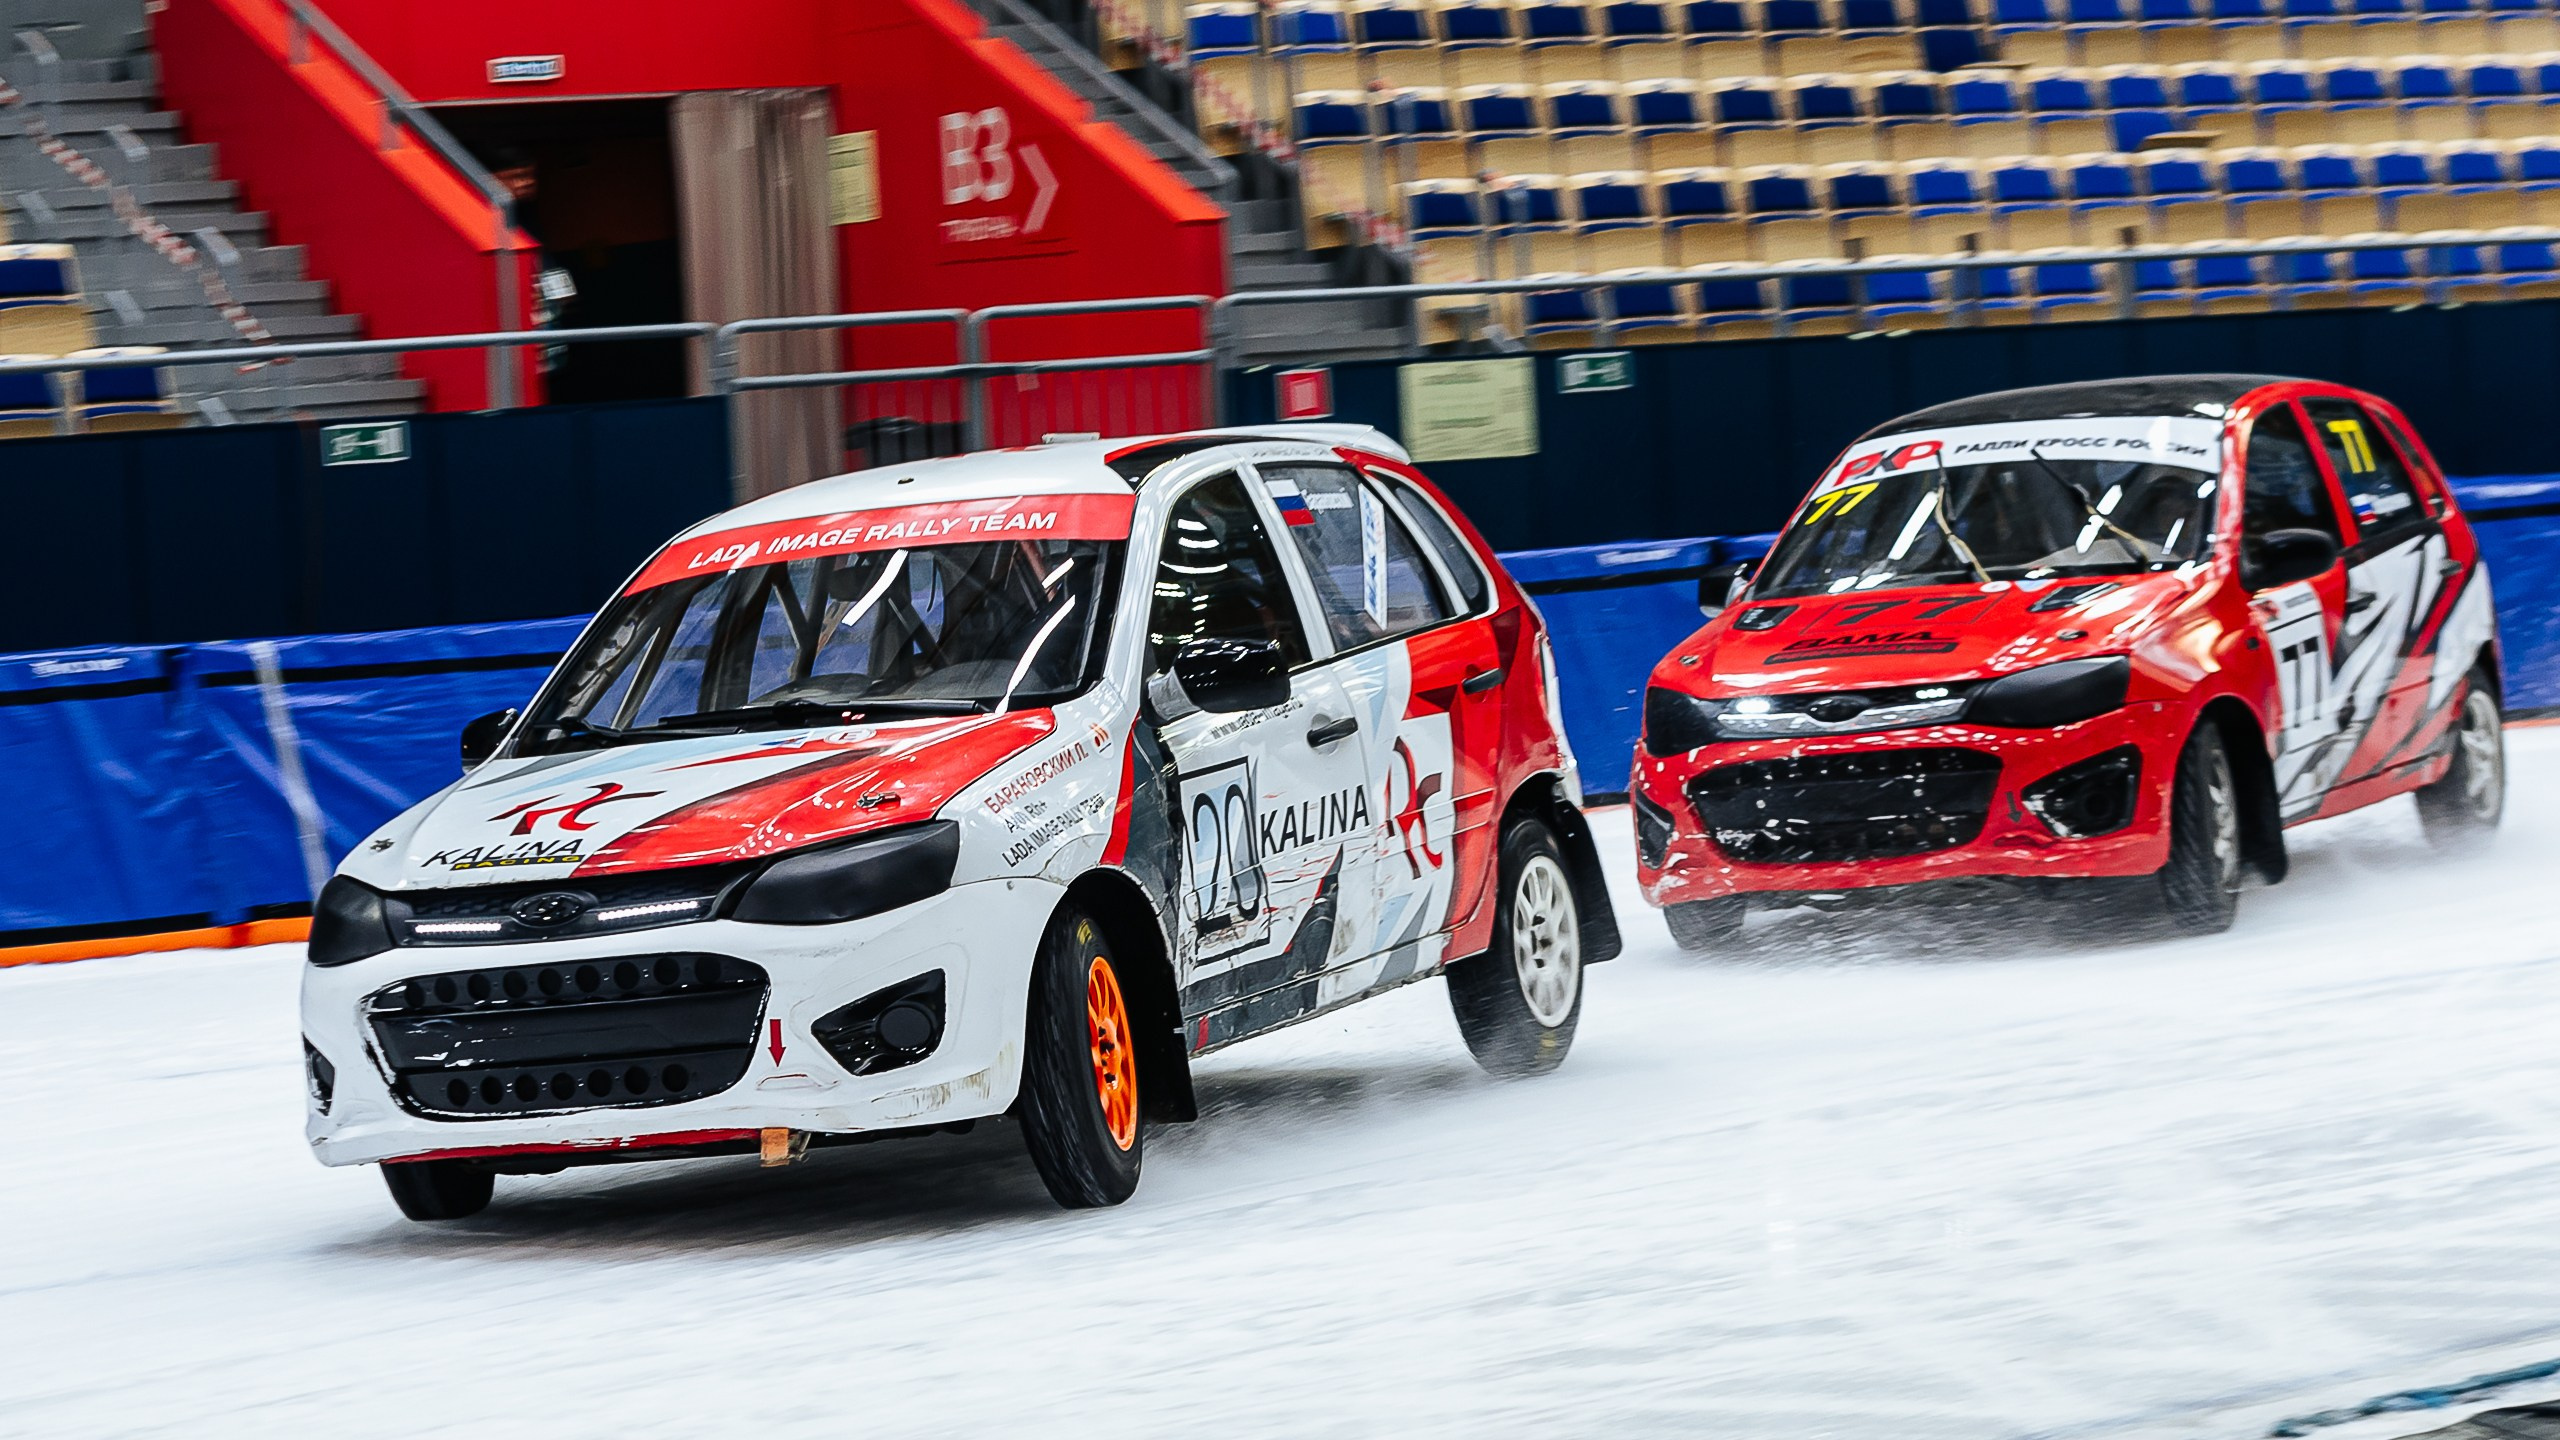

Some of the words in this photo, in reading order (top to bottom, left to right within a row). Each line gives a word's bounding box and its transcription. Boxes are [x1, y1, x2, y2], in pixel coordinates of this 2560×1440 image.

[1954, 439, 2029, 454] РАЛЛИ
[2034, 437, 2107, 449] КРОСС
[2327, 419, 2376, 474] 77
[1804, 482, 1880, 526] 77
[687, 540, 761, 570] LADA
[766, 526, 859, 556] IMAGE
[863, 517, 962, 543] RALLY
[967, 511, 1057, 533] TEAM
[1835, 595, 1988, 626] 77
[2281, 636, 2321, 728] 77
[1002, 838, 1037, 868] LADA
[1029, 817, 1064, 848] IMAGE
[1260, 784, 1370, 859] KALINA
[421, 838, 583, 867] KALINA
[454, 855, 580, 869] RACING
[1192, 783, 1262, 934] 20
